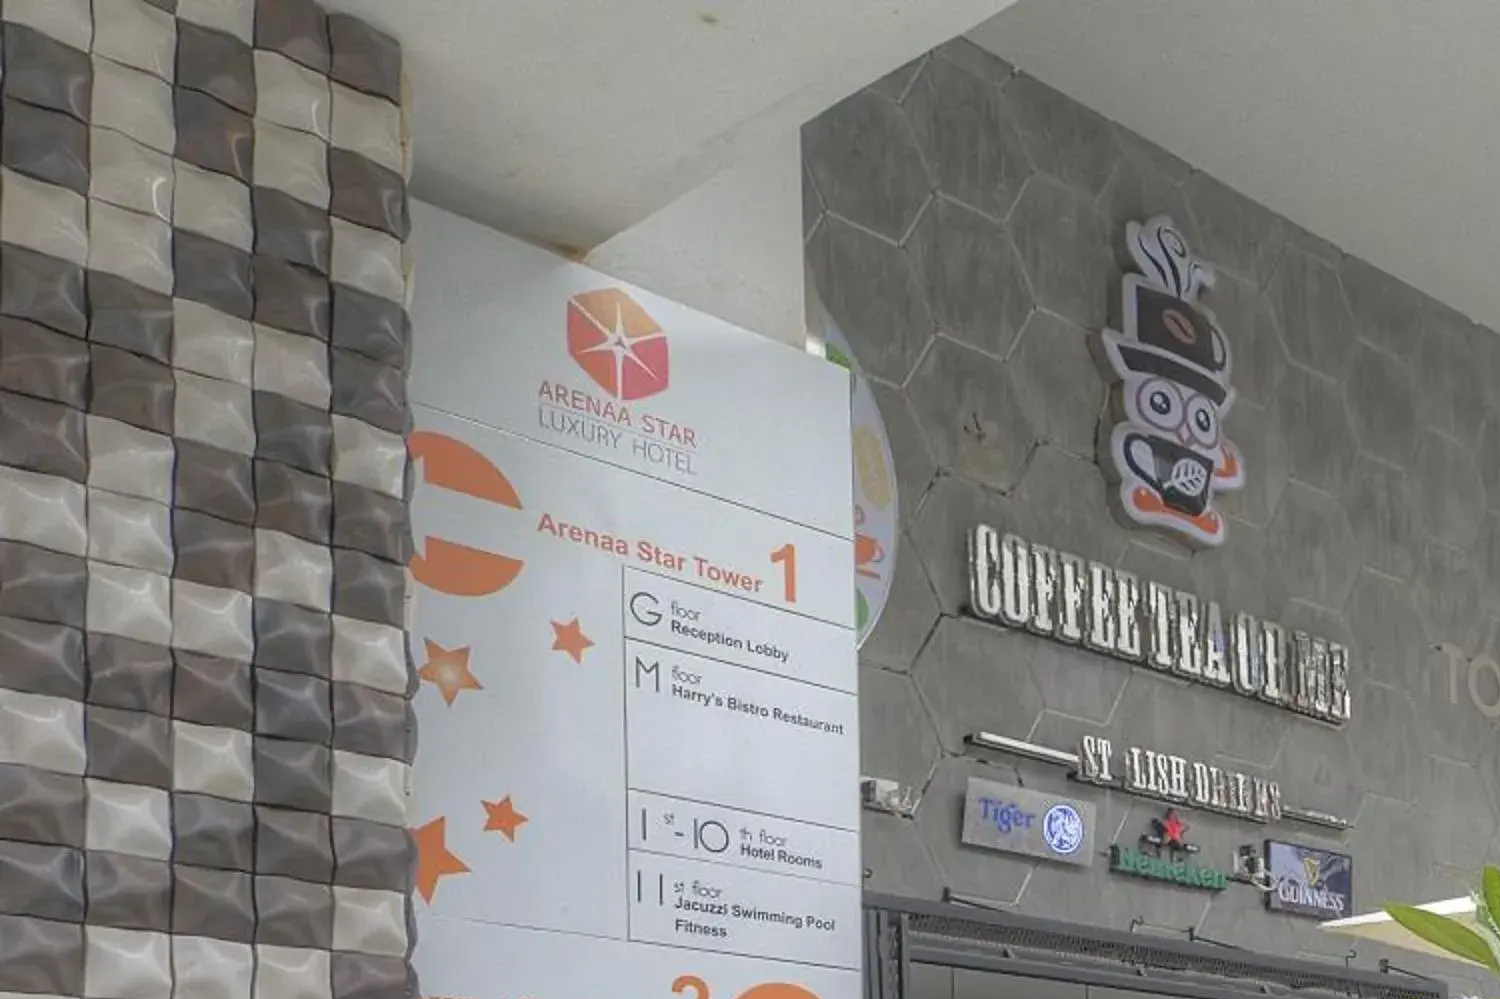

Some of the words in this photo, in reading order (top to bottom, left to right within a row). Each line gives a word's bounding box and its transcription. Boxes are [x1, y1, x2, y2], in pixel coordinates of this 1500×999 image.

[539, 380, 633, 428] ARENAA
[642, 413, 698, 448] STAR
[538, 409, 623, 450] LUXURY
[633, 440, 698, 476] HOTEL
[538, 512, 629, 557] Arenaa
[637, 540, 686, 573] Star
[693, 555, 765, 594] Tower
[769, 542, 797, 604] 1
[629, 591, 662, 626] G
[671, 600, 702, 623] floor
[968, 524, 1140, 660] COFFEE
[1146, 580, 1231, 685] TEA
[671, 619, 743, 651] Reception
[747, 638, 790, 664] Lobby
[635, 655, 660, 693] M
[672, 664, 703, 685] floor
[672, 684, 723, 708] Harry's
[728, 697, 770, 718] Bistro
[773, 707, 845, 736] Restaurant
[978, 797, 1036, 835] Tiger
[740, 844, 775, 862] Hotel
[777, 852, 823, 870] Rooms
[759, 829, 787, 848] floor
[692, 880, 722, 899] floor
[1277, 879, 1345, 912] GUINNESS
[674, 898, 728, 917] Jacuzzi
[731, 905, 803, 930] Swimming
[806, 915, 836, 932] Pool
[675, 919, 727, 939] Fitness
